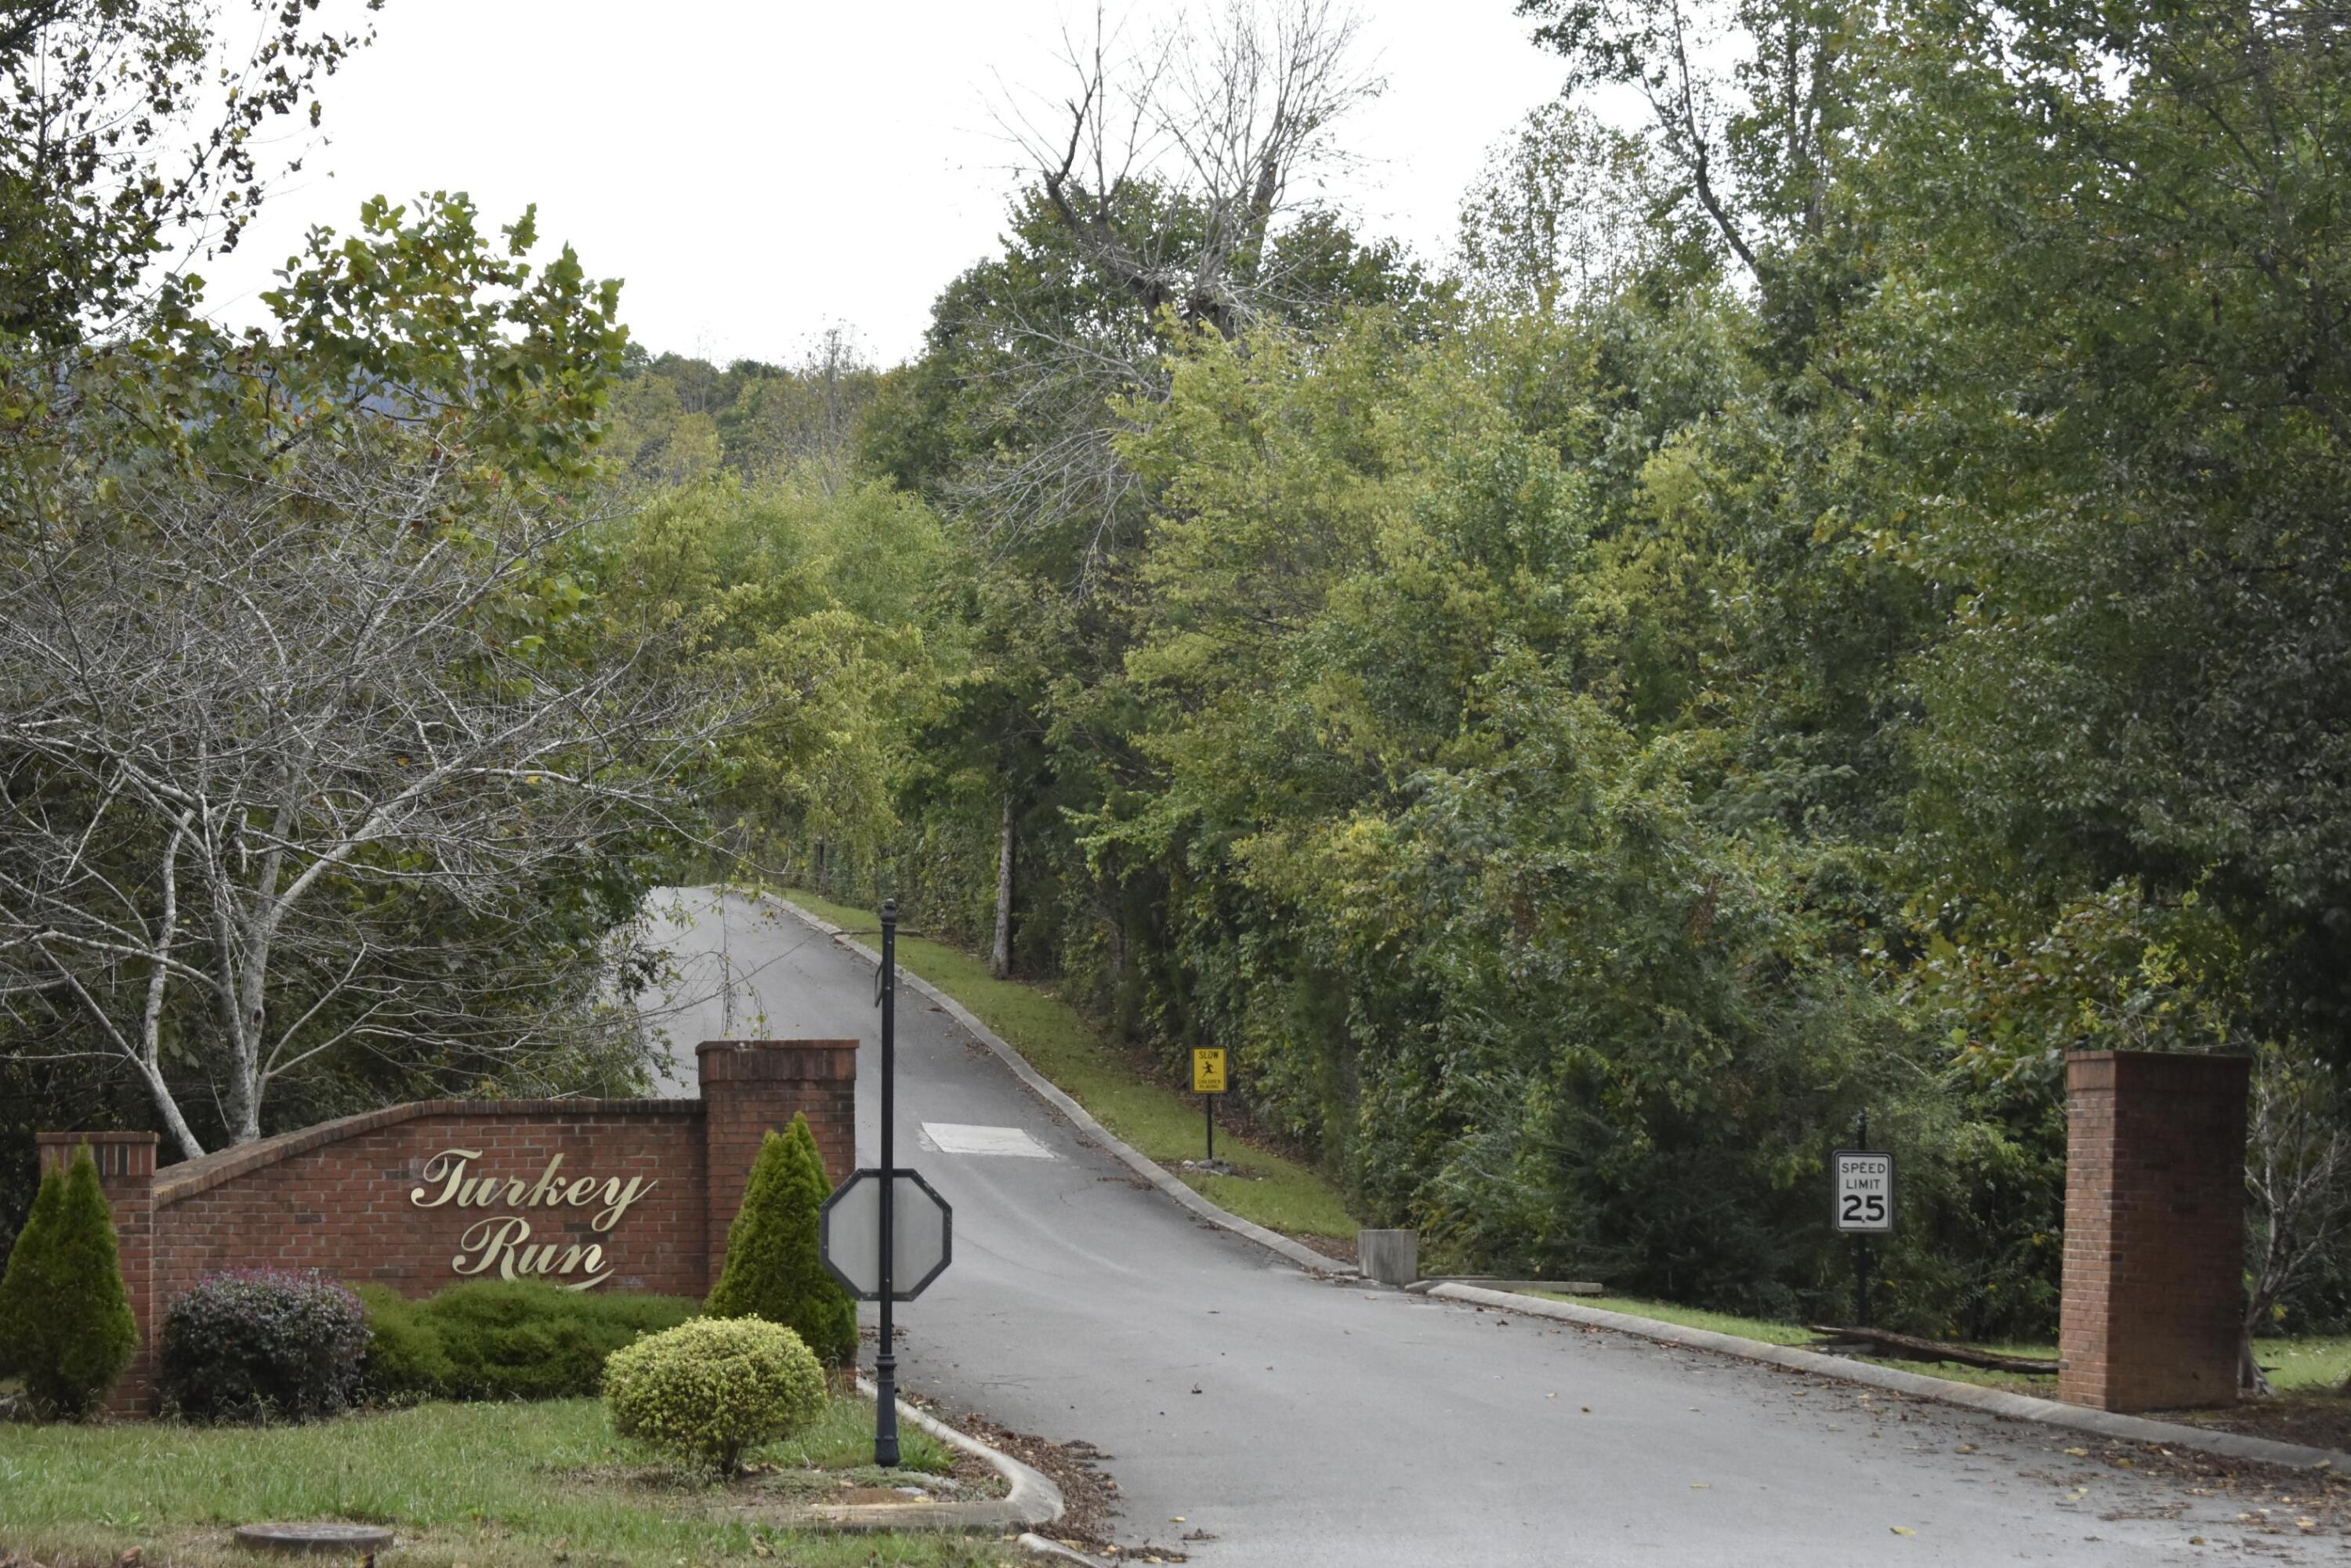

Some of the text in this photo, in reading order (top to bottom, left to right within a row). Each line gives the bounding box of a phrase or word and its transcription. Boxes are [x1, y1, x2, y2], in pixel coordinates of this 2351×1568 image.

[1842, 1162, 1886, 1173] SPEED
[411, 1149, 658, 1232] Turkey
[1846, 1179, 1881, 1190] LIMIT
[1842, 1194, 1885, 1222] 25
[452, 1216, 615, 1291] Run
